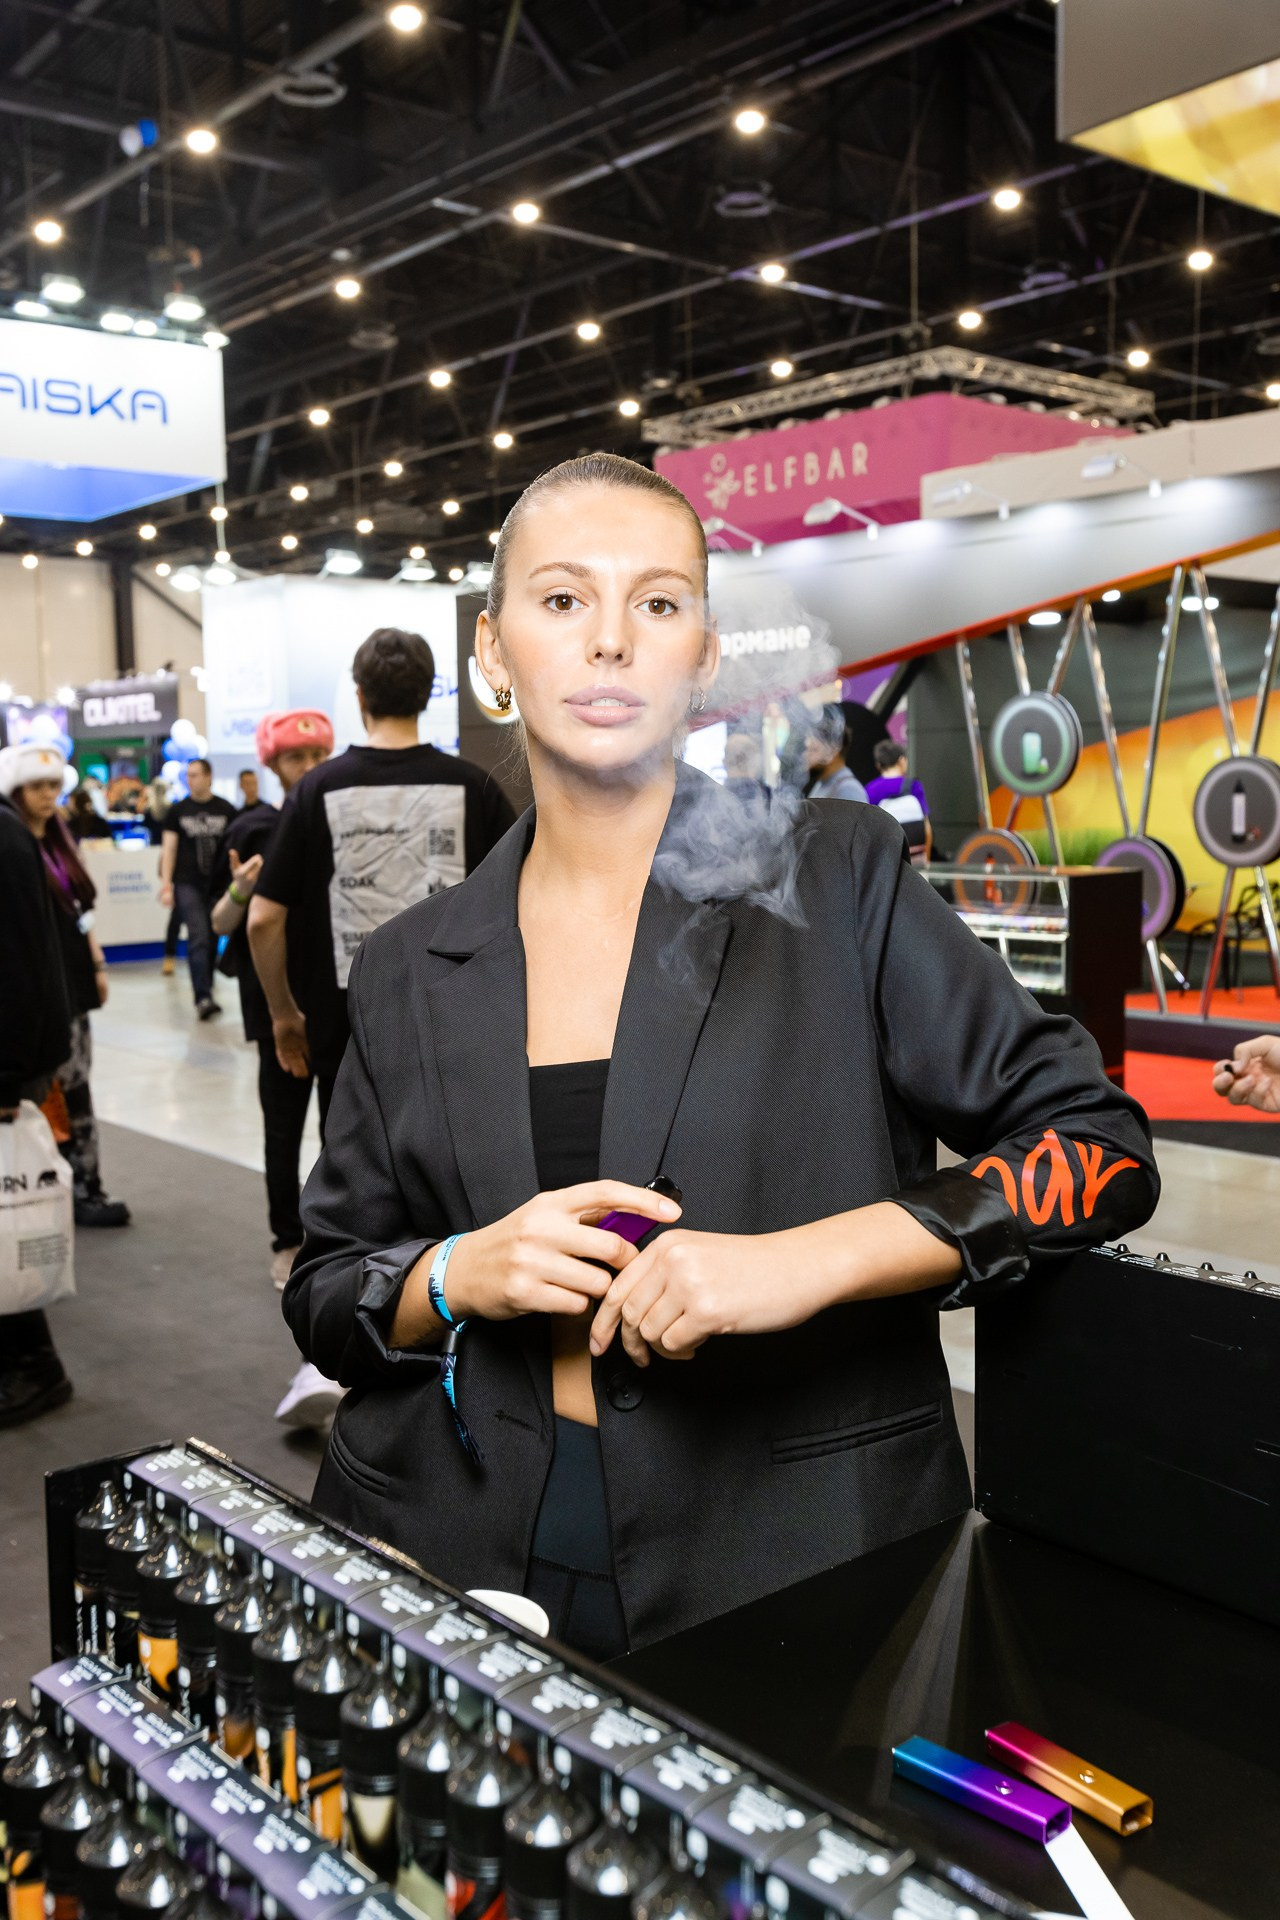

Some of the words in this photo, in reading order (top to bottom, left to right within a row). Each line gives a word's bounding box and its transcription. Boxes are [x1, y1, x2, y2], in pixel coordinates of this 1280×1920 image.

[0, 373, 168, 424] AISKA
[743, 441, 868, 497] ELFBAR
[339, 876, 376, 889] SOAK
